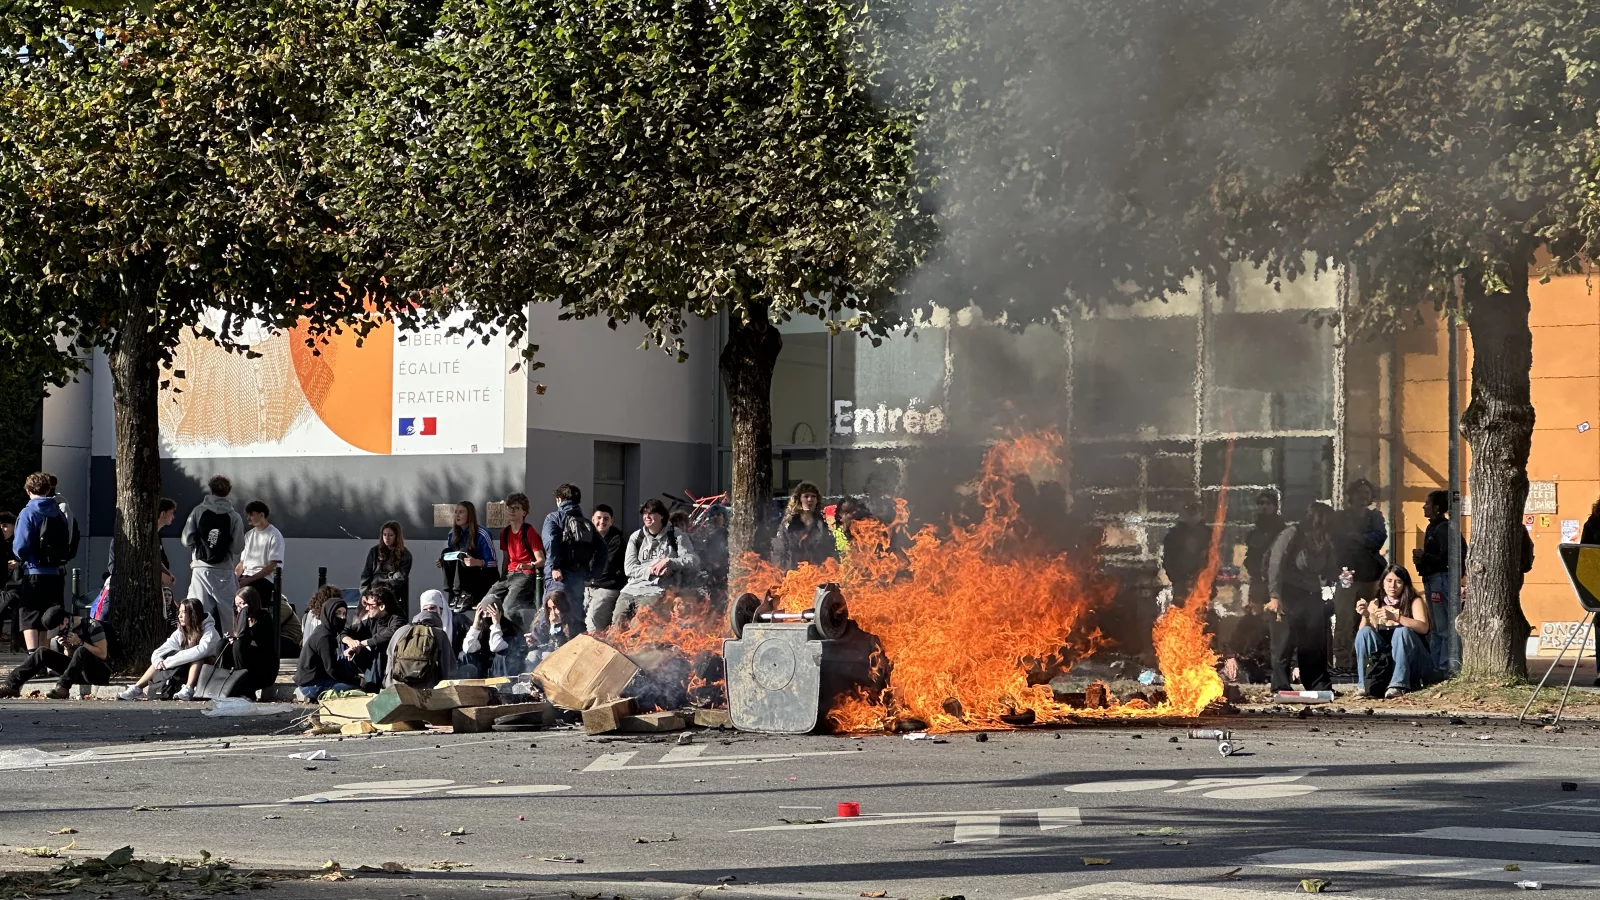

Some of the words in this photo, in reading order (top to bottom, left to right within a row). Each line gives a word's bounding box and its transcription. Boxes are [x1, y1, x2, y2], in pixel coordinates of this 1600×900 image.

[399, 358, 460, 375] ÉGALITÉ
[398, 386, 490, 404] FRATERNITÉ
[834, 397, 945, 435] Entrée
